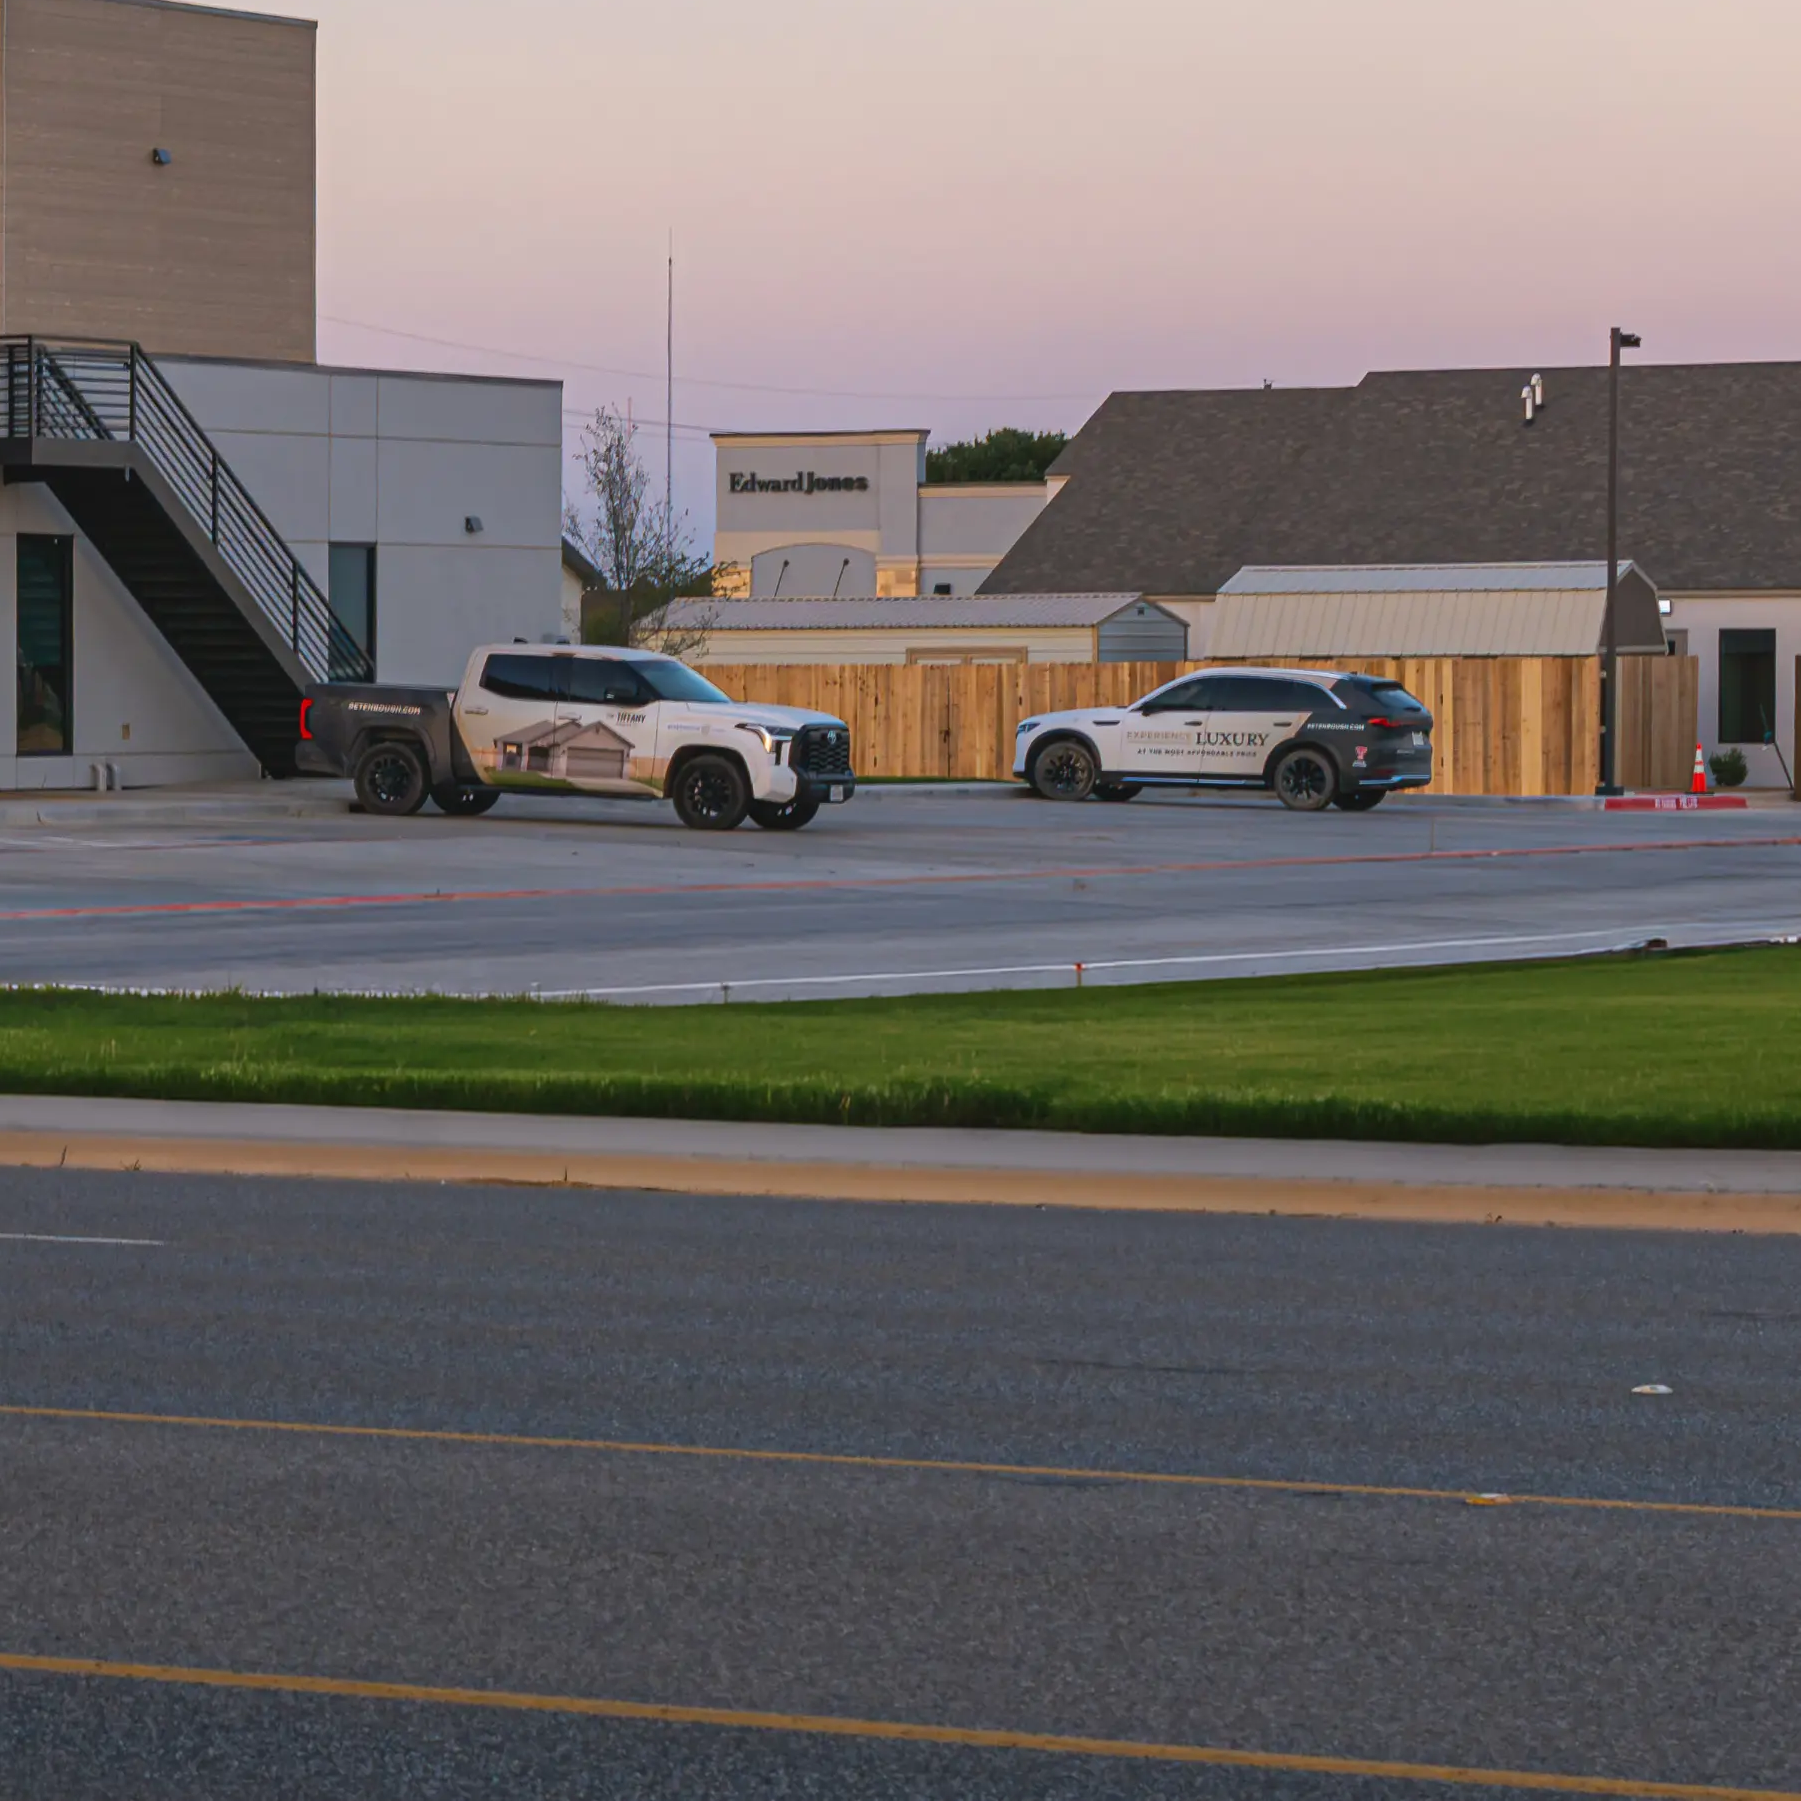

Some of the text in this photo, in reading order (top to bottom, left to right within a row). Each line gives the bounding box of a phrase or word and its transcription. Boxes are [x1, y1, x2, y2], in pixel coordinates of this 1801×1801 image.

[728, 471, 869, 495] Edward Jones
[1127, 730, 1269, 746] EXPERIENCE LUXURY
